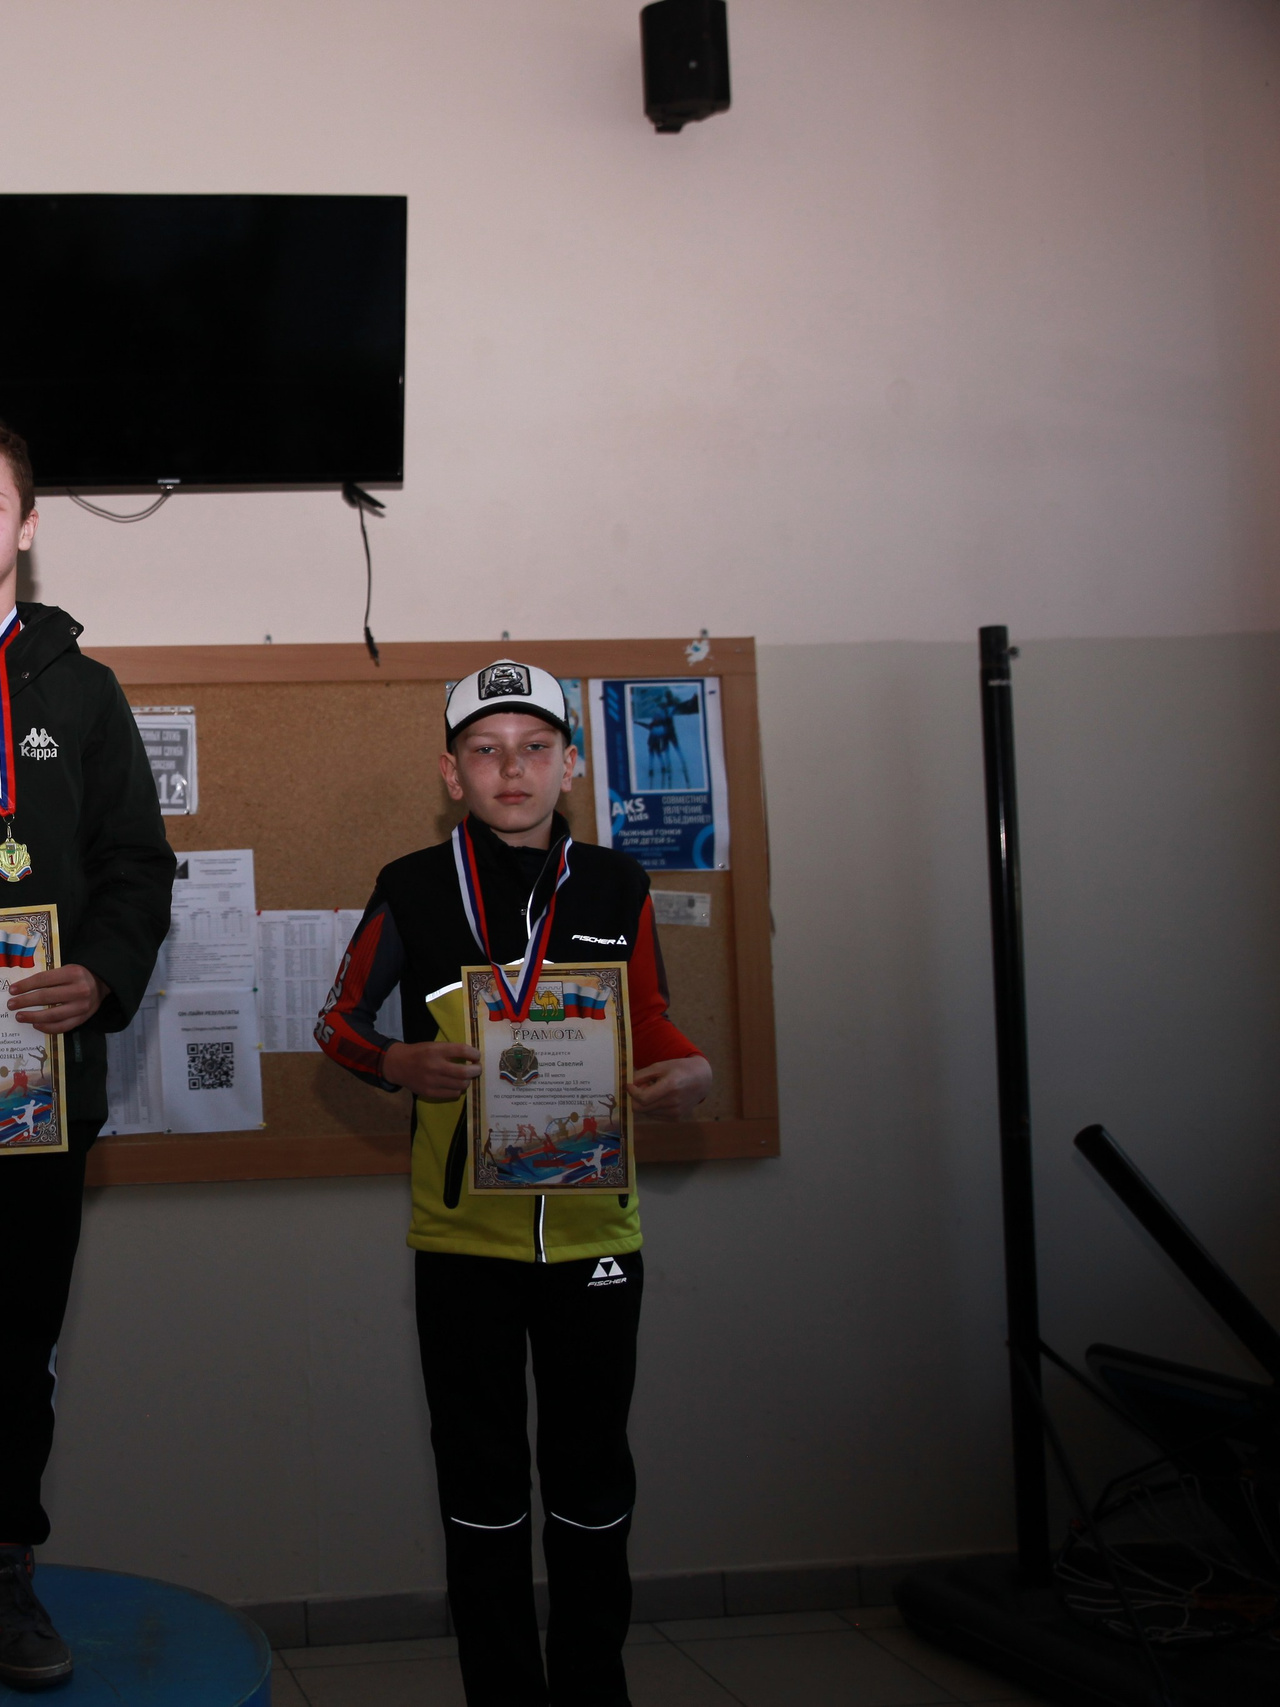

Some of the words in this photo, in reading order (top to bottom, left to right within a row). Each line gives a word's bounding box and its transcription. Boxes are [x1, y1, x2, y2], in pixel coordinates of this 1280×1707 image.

[20, 745, 58, 761] Kappa
[158, 772, 186, 804] 12
[661, 795, 708, 805] СОВМЕСТНОЕ
[611, 797, 646, 817] AKS
[663, 805, 703, 814] УВЛЕЧЕНИЕ
[627, 812, 649, 823] kids
[618, 829, 654, 837] ЛЫЖНЫЕ
[655, 828, 682, 837] ГОНКИ
[622, 838, 639, 846] ДЛЯ
[639, 837, 665, 846] ДЕТЕЙ
[8, 854, 15, 866] 1
[571, 934, 616, 945] FISCHER
[512, 1029, 585, 1040] ГРАМОТА
[587, 1277, 627, 1287] FISCHER
